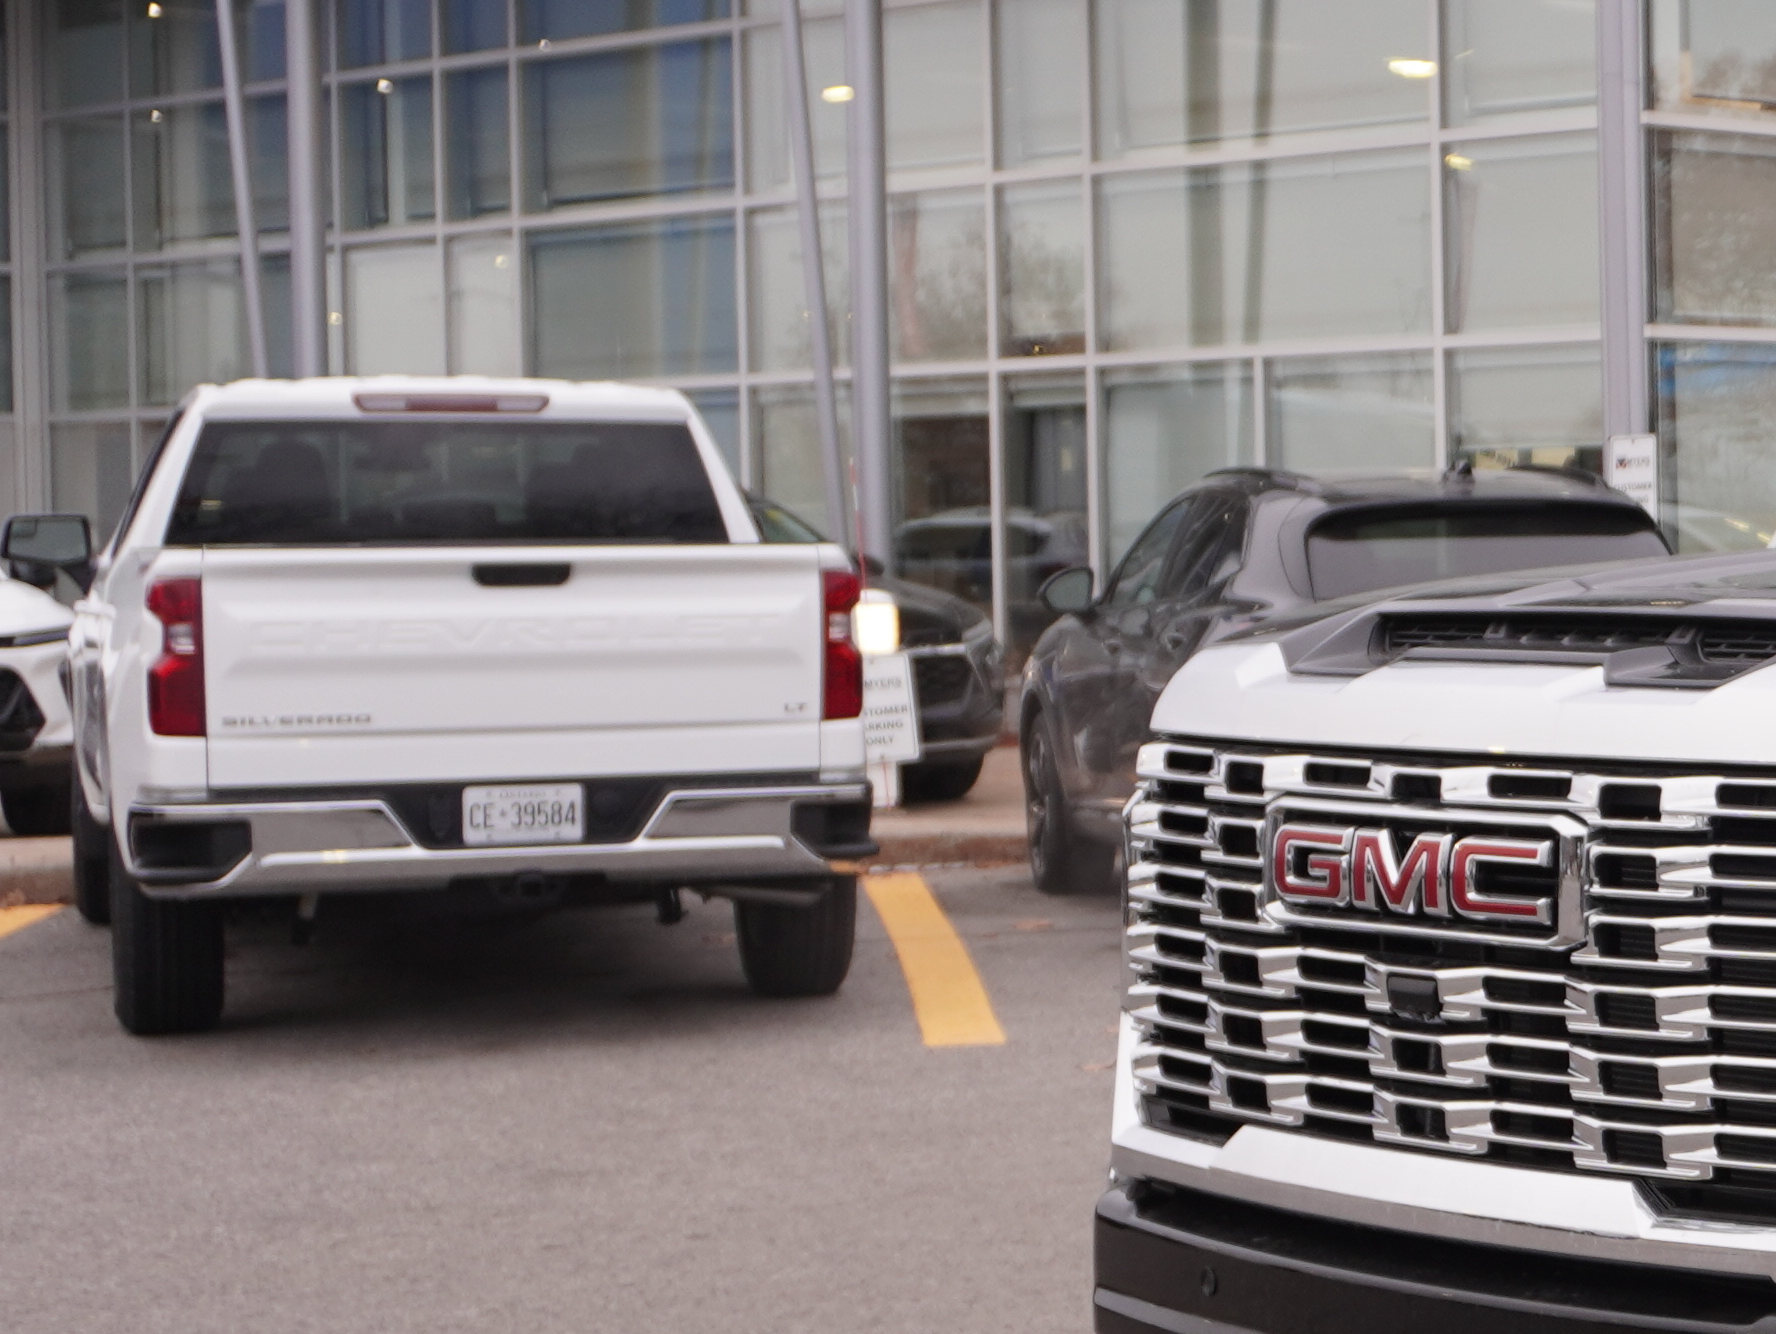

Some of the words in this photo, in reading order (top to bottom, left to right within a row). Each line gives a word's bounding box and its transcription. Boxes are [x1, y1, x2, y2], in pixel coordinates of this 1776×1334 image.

[222, 713, 372, 728] SILVERADO
[865, 720, 904, 732] RKING
[866, 735, 894, 746] ONLY
[1271, 822, 1553, 927] GMC
